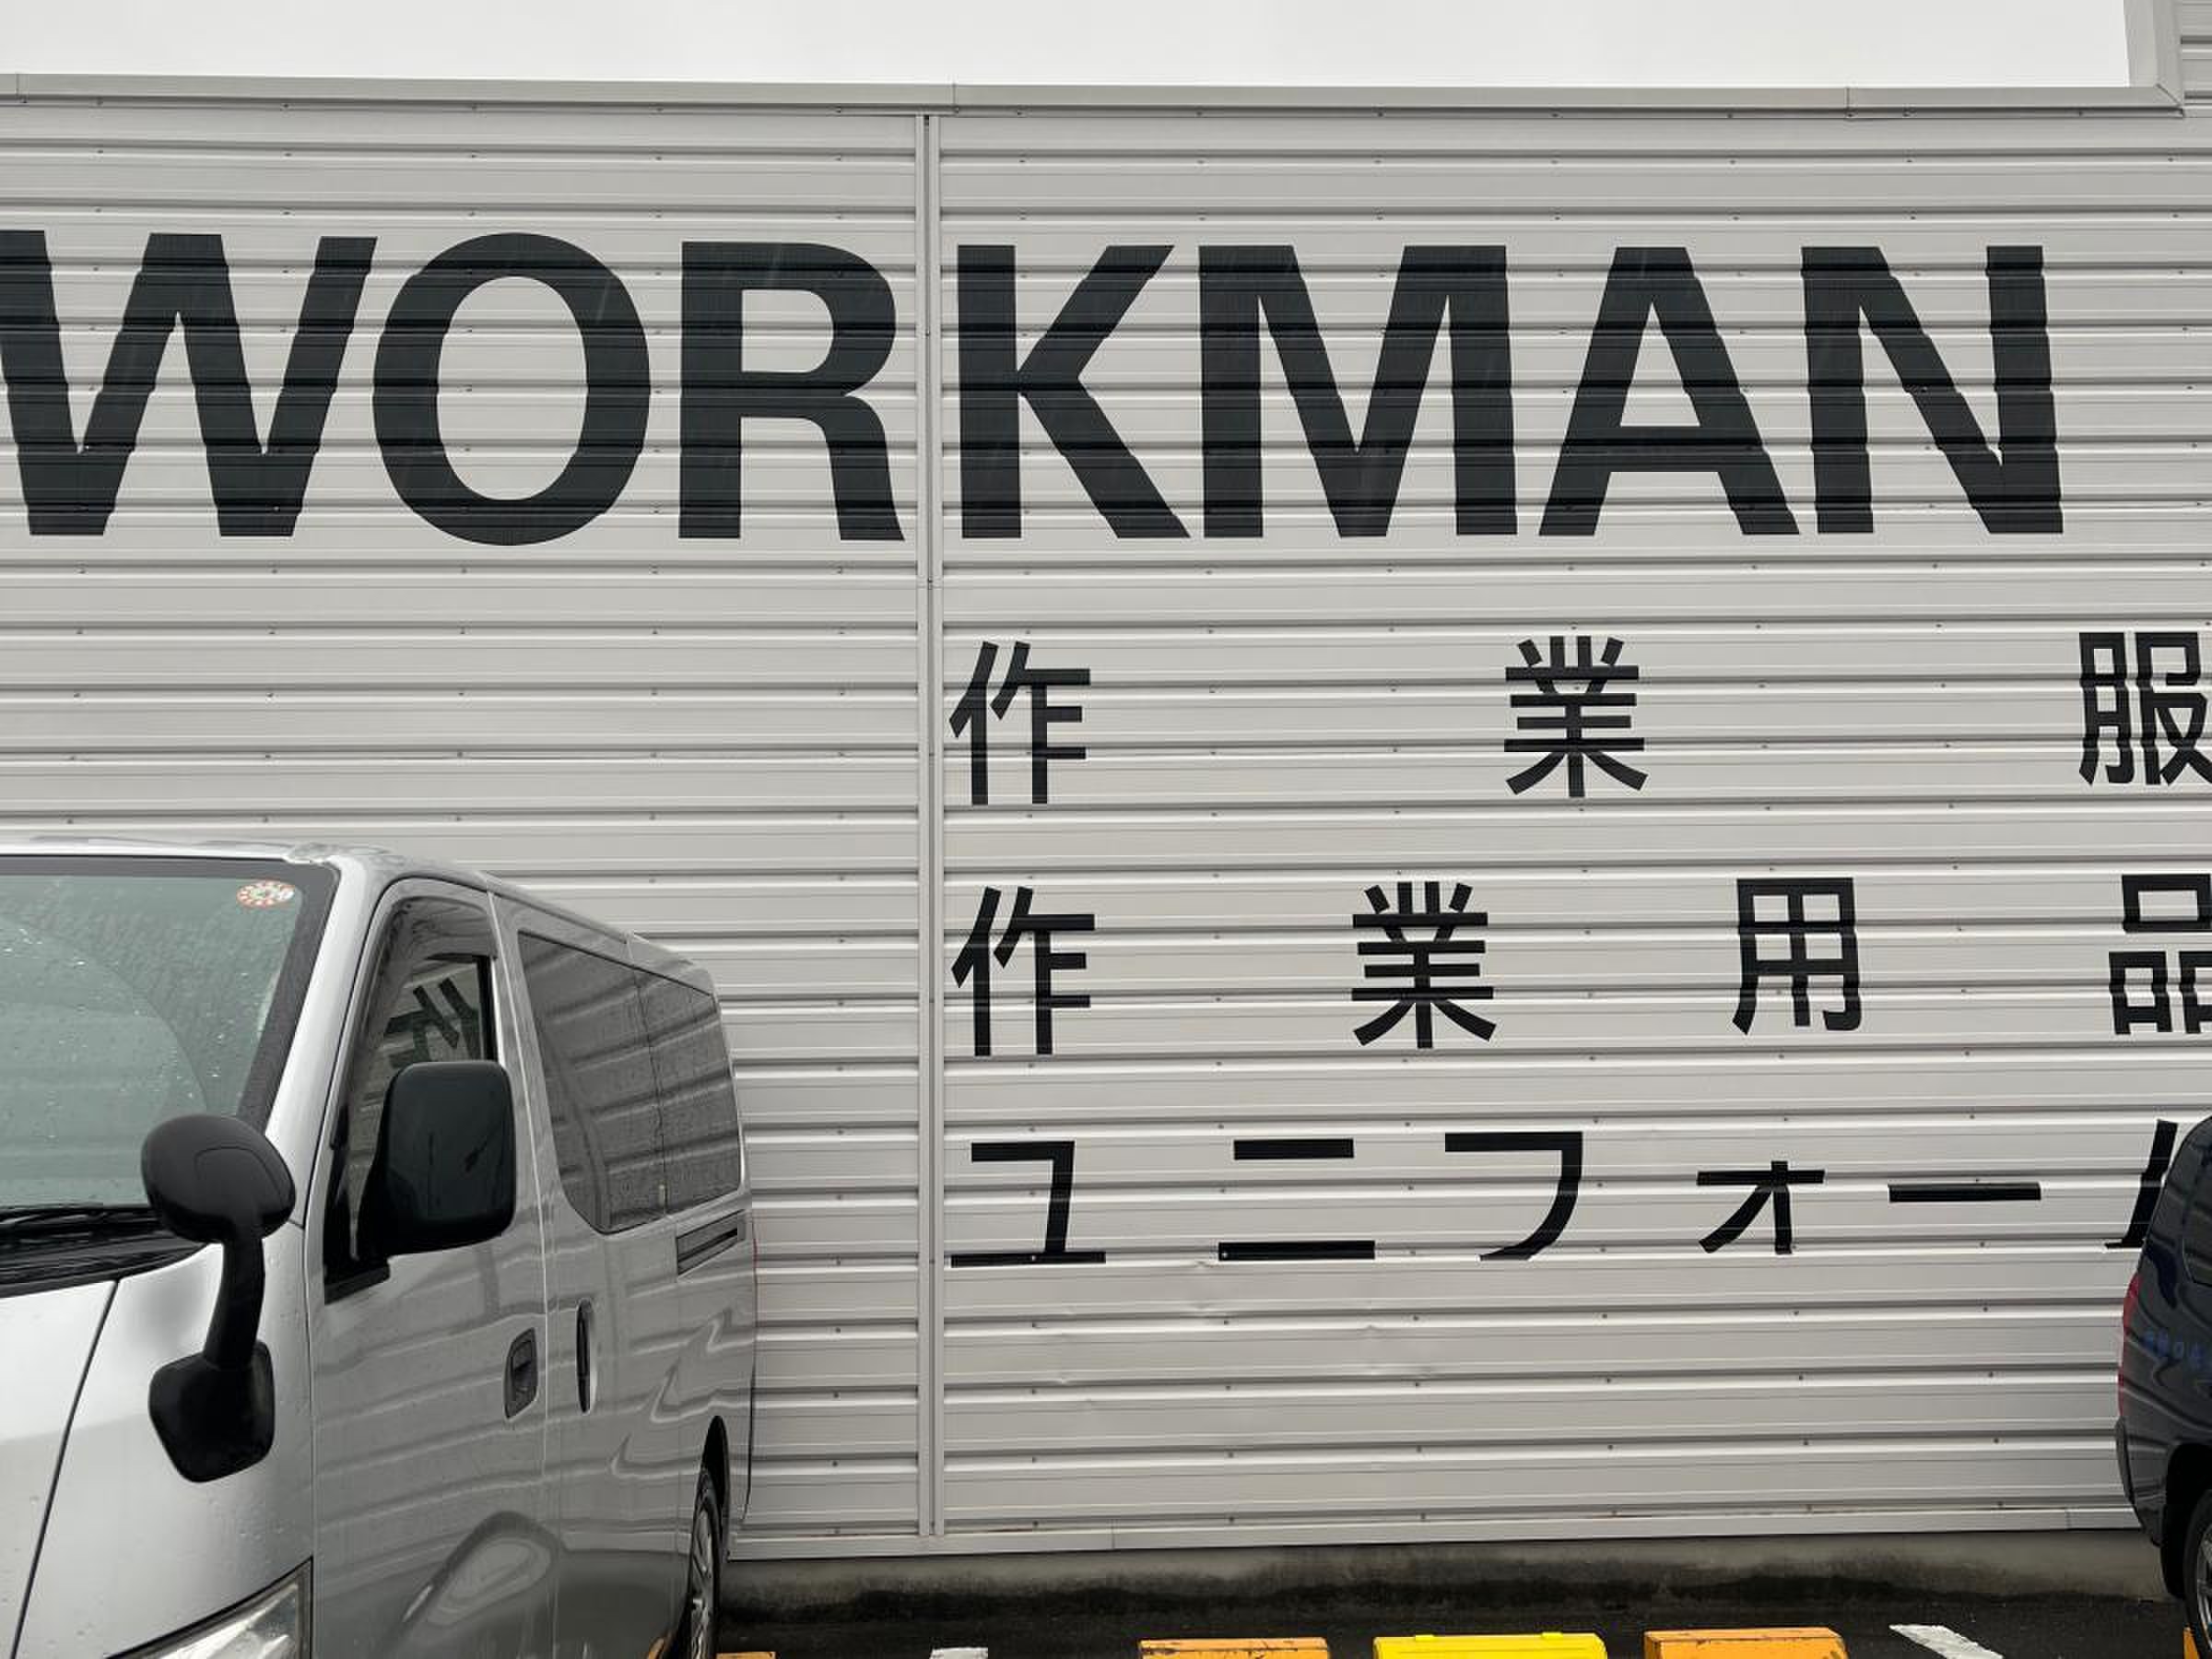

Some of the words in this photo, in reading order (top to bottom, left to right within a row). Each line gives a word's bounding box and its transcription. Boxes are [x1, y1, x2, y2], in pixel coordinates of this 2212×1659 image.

[0, 229, 2064, 546] WORKMAN
[948, 631, 2212, 806] 作業服
